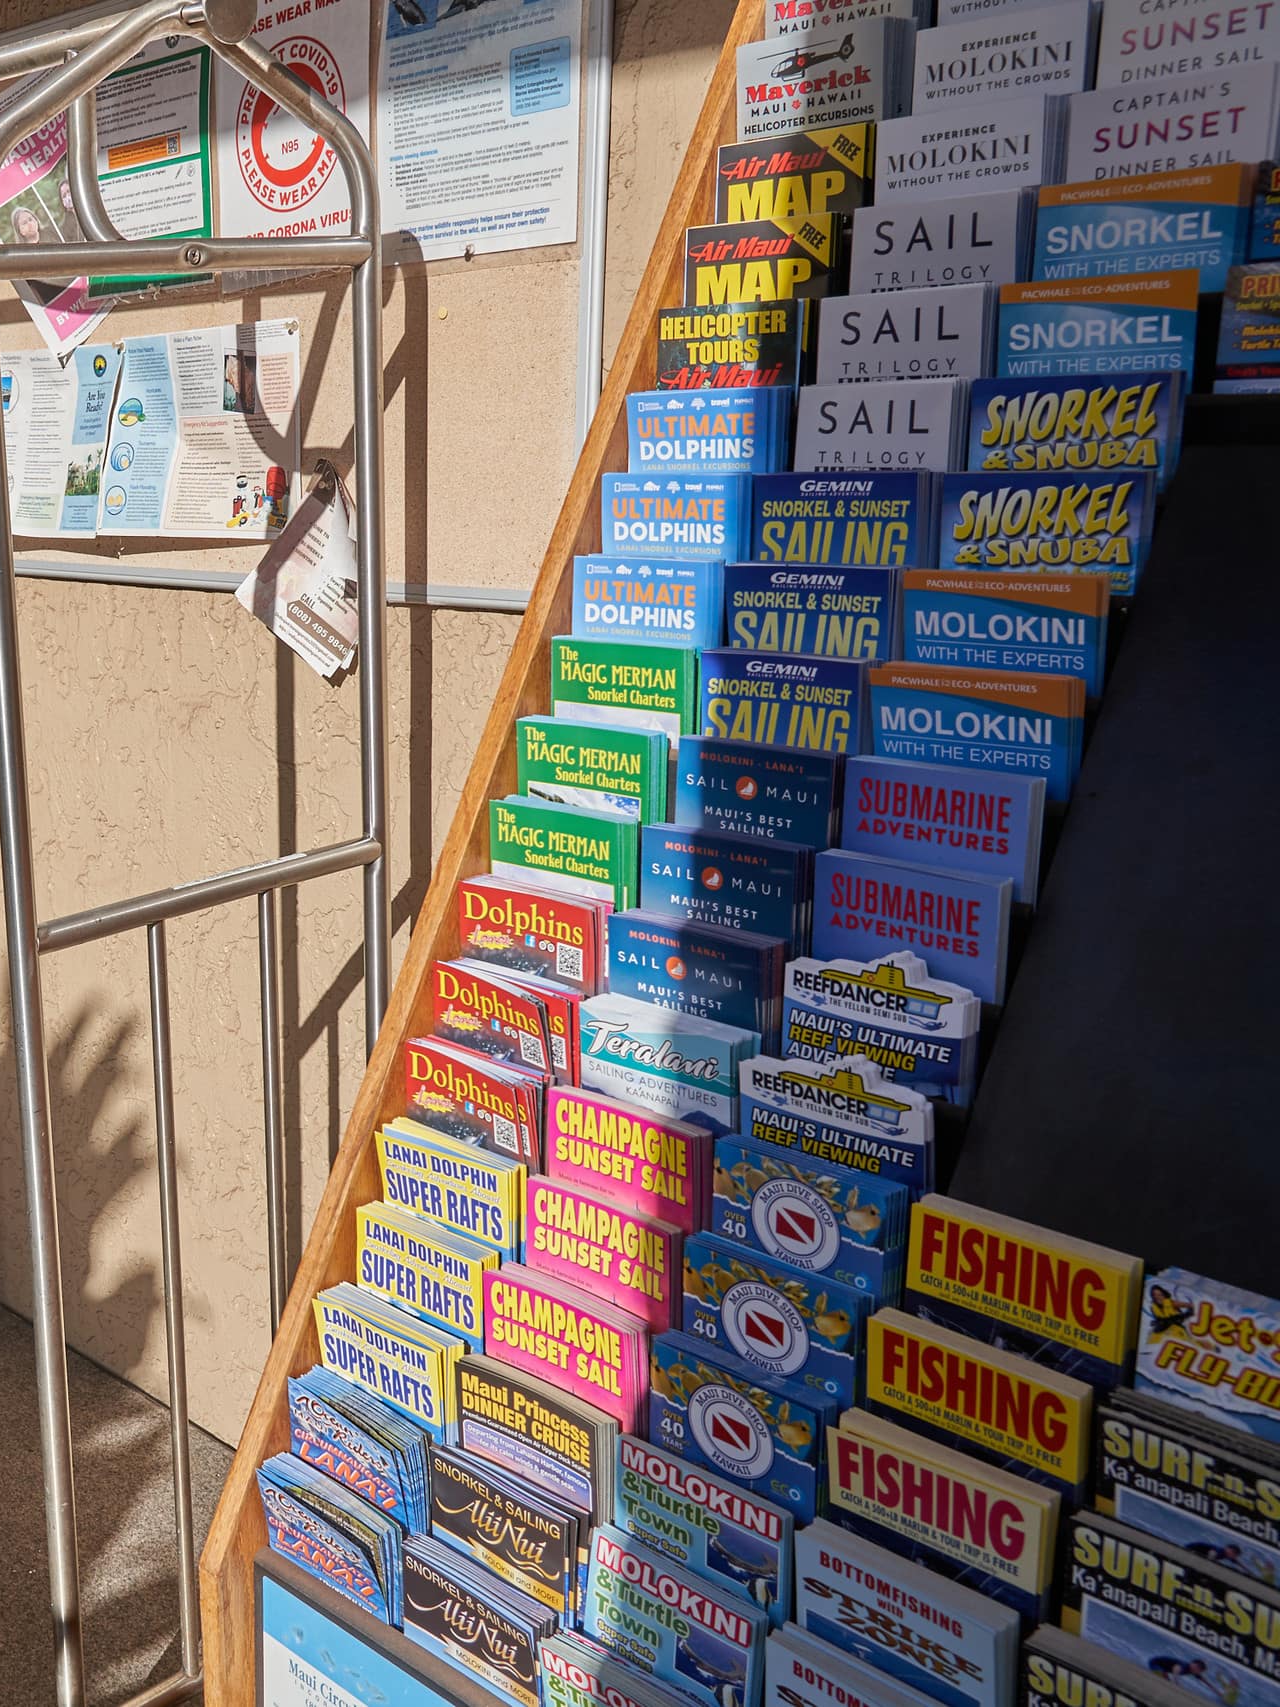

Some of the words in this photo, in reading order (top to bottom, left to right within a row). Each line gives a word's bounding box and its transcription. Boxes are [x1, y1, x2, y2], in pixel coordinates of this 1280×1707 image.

[276, 2, 312, 25] WEAR
[779, 20, 815, 34] MAUI
[836, 3, 891, 23] HAWAII
[1120, 3, 1275, 55] SUNSET
[961, 31, 1037, 51] EXPERIENCE
[290, 43, 338, 95] COVID-19
[925, 41, 1072, 85] MOLOKINI
[1121, 56, 1203, 83] DINNER
[1215, 46, 1264, 66] SAIL
[745, 65, 871, 104] Maverick
[751, 102, 786, 117] MAUI
[807, 89, 862, 108] HAWAII
[744, 115, 805, 135] HELICOPTER
[808, 105, 874, 124] EXCURSIONS
[922, 124, 996, 144] EXPERIENCE
[1093, 106, 1246, 153] SUNSET
[281, 139, 299, 155] N95
[720, 156, 767, 180] Air
[766, 146, 828, 175] Maui
[831, 134, 861, 162] FREE
[886, 134, 1031, 176] MOLOKINI
[242, 149, 275, 205] PLEASE
[279, 176, 318, 206] WEAR
[888, 175, 943, 190] WITHOUT
[948, 170, 970, 182] THE
[976, 162, 1030, 178] CROWDS
[727, 170, 846, 223] MAP
[689, 239, 734, 263] Air
[732, 233, 795, 259] Maui
[798, 222, 827, 250] FREE
[873, 212, 993, 255] SAIL
[1046, 211, 1222, 254] SNORKEL
[695, 258, 812, 306] MAP
[875, 264, 991, 285] TRILOGY
[660, 309, 787, 340] HELICOPTER
[840, 305, 959, 345] SAIL
[1009, 315, 1182, 351] SNORKEL
[686, 338, 760, 365] TOURS
[842, 358, 956, 374] TRILOGY
[1008, 358, 1051, 376] WITH
[1056, 358, 1090, 372] THE
[1096, 353, 1182, 370] EXPERTS
[86, 391, 96, 402] Are
[981, 382, 1162, 446] SNORKEL
[637, 413, 756, 438] ULTIMATE
[639, 438, 755, 461] DOLPHINS
[982, 450, 1009, 470] &
[1013, 438, 1158, 470] SNUBA
[770, 572, 845, 586] GEMINI
[926, 579, 973, 589] PACWHALE
[984, 581, 1071, 593] ECO-ADVENTURES
[300, 593, 316, 610] CALL
[733, 591, 802, 610] SNORKEL
[806, 594, 816, 610] &
[821, 595, 881, 614] SUNSET
[289, 603, 311, 625] (808)
[312, 621, 327, 638] 495
[559, 645, 579, 662] The
[560, 661, 607, 685] MAGIC
[611, 665, 677, 691] MERMAN
[587, 685, 628, 704] Snorkel
[630, 689, 676, 709] Charters
[880, 706, 1053, 745] MOLOKINI
[883, 739, 926, 756] WITH
[930, 743, 964, 761] THE
[969, 748, 1052, 770] EXPERTS
[858, 777, 1012, 833] SUBMARINE
[856, 818, 1009, 855] ADVENTURES
[651, 863, 695, 881] SAIL
[731, 877, 782, 898] MAUI
[462, 891, 584, 945] Dolphins
[670, 894, 719, 912] MAUI'S
[725, 904, 759, 920] BEST
[686, 909, 742, 929] SAILING
[829, 997, 842, 1007] THE
[844, 1000, 871, 1014] YELLOW
[873, 1006, 891, 1019] SEMI
[893, 1011, 907, 1023] SUB
[586, 1019, 720, 1081] Teralani
[588, 1060, 635, 1084] SAILING
[638, 1075, 718, 1108] ADVENTURES
[752, 1070, 869, 1118] REEFDANCER
[555, 1098, 687, 1177] CHAMPAGNE
[751, 1123, 798, 1148] REEF
[801, 1136, 881, 1174] VIEWING
[752, 1107, 817, 1138] MAUI'S
[821, 1129, 916, 1168] ULTIMATE
[384, 1140, 428, 1166] LANAI
[431, 1153, 497, 1193] DOLPHIN
[555, 1136, 635, 1184] SUNSET
[641, 1165, 687, 1206] SAIL
[386, 1168, 444, 1218] SUPER
[447, 1190, 503, 1242] RAFTS
[723, 1209, 746, 1224] OVER
[758, 1182, 784, 1204] MAUI
[786, 1182, 811, 1202] DIVE
[810, 1196, 835, 1229] SHOP
[722, 1220, 747, 1239] 40
[774, 1248, 815, 1270] HAWAII
[920, 1213, 1107, 1332] FISHING
[920, 1272, 943, 1289] CATCH
[944, 1279, 951, 1291] A
[952, 1282, 980, 1302] 500+LB
[980, 1291, 1011, 1313] MARLIN
[1012, 1303, 1019, 1316] &
[1020, 1306, 1042, 1325] YOUR
[1044, 1313, 1062, 1332] TRIP
[1063, 1320, 1071, 1336] IS
[1073, 1325, 1100, 1347] FREE
[461, 1371, 508, 1398] Maui
[513, 1390, 590, 1446] Princess
[462, 1390, 527, 1434] DINNER
[531, 1419, 591, 1468] CRUISE
[434, 1457, 496, 1503] SNORKEL
[494, 1493, 503, 1507] &
[504, 1500, 561, 1540] SAILING
[621, 1439, 782, 1541] MOLOKINI
[622, 1470, 641, 1493] &
[639, 1475, 720, 1535] Turtle
[1103, 1457, 1209, 1515] Ka'anapali
[623, 1495, 691, 1546] Town
[627, 1520, 661, 1546] Super
[662, 1538, 687, 1560] Safe
[481, 1551, 514, 1582] MOLOKINI
[515, 1575, 531, 1590] and
[532, 1581, 560, 1605] MORE!
[820, 1551, 964, 1639] BOTTOMFISHING
[876, 1598, 905, 1620] with
[802, 1577, 984, 1683] STRIKE
[837, 1608, 961, 1686] ZONE
[288, 1659, 317, 1692] Maui
